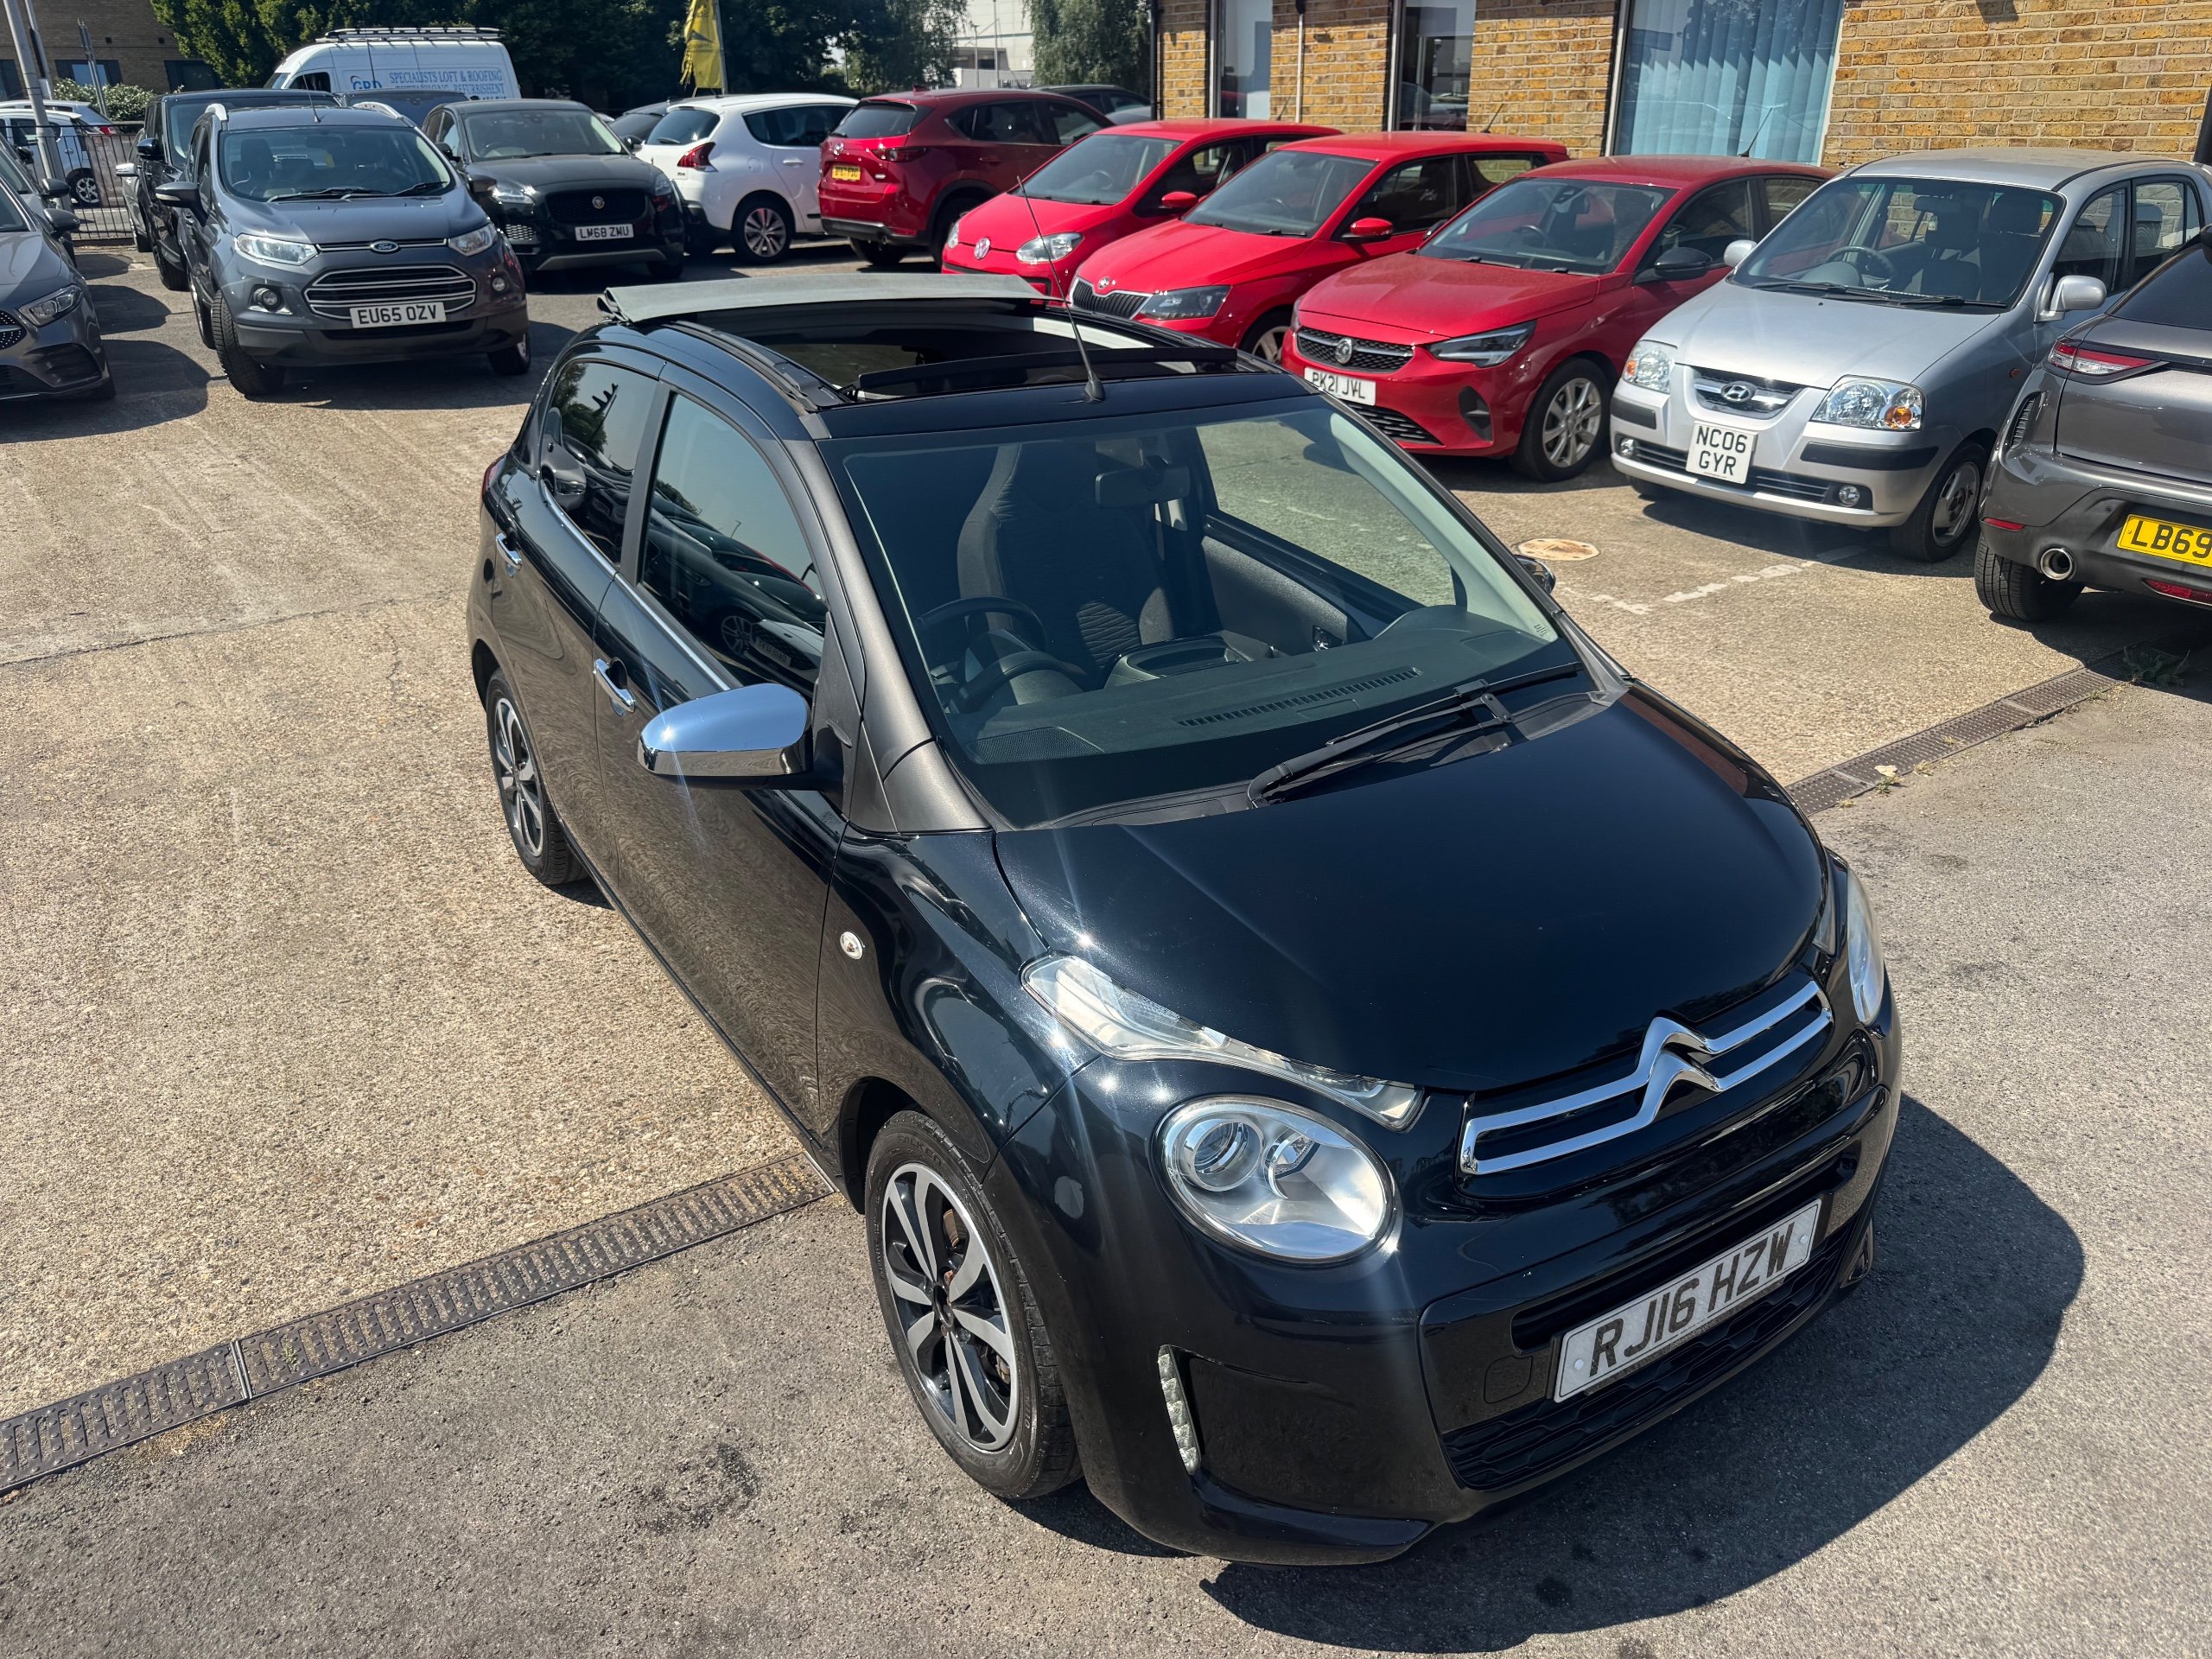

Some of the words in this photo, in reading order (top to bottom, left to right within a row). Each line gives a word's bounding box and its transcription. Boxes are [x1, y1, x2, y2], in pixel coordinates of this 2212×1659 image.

[389, 71, 437, 83] SPECIALISTS
[438, 71, 458, 82] LOFT
[467, 70, 503, 82] ROOFING
[357, 307, 402, 325] EU65
[405, 304, 436, 321] OZV
[1342, 378, 1366, 399] JVL
[1696, 425, 1748, 454] NC06
[1699, 450, 1737, 476] GYR
[2131, 520, 2212, 559] LB69
[1588, 1277, 1700, 1378] RJ16
[1707, 1221, 1796, 1313] HZW
